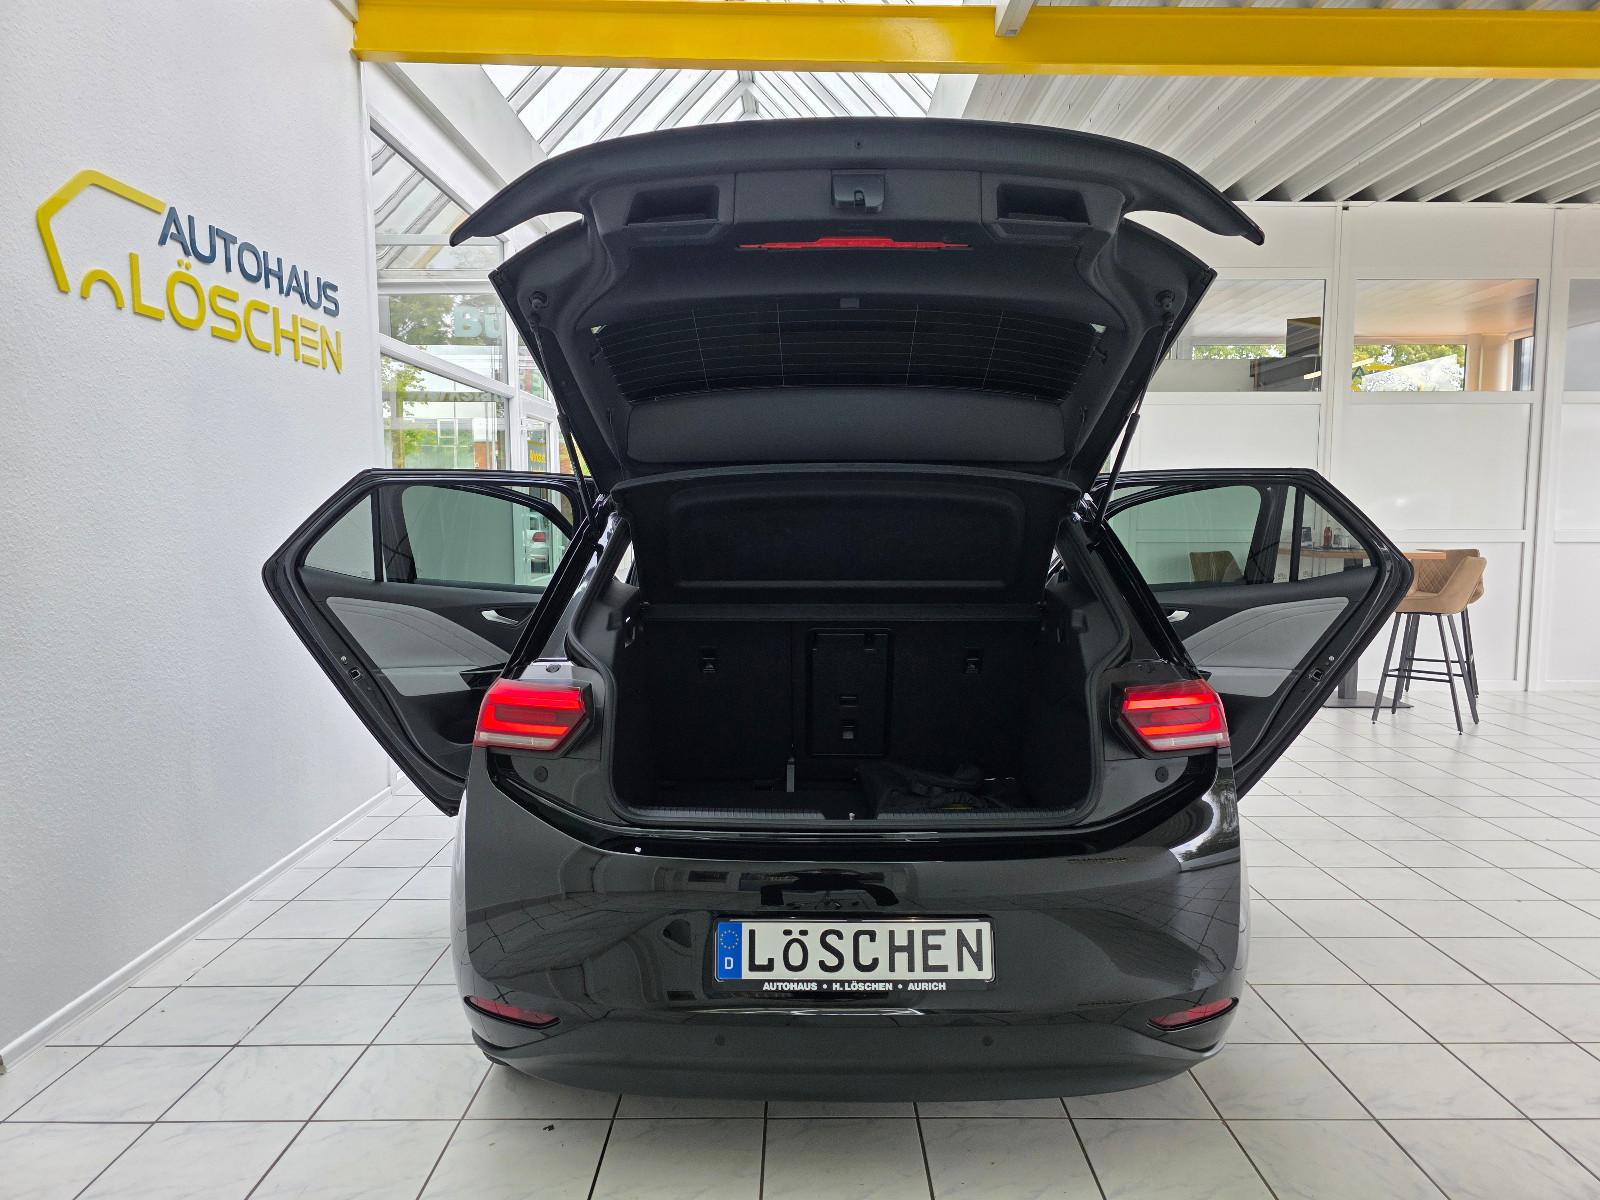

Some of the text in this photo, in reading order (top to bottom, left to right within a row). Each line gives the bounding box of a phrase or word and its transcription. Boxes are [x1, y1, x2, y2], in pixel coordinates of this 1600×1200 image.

[157, 206, 340, 318] AUTOHAUS
[128, 252, 343, 375] LÖSCHEN
[724, 956, 734, 970] D
[762, 982, 818, 991] AUTOHAUS
[907, 982, 947, 991] AURICH
